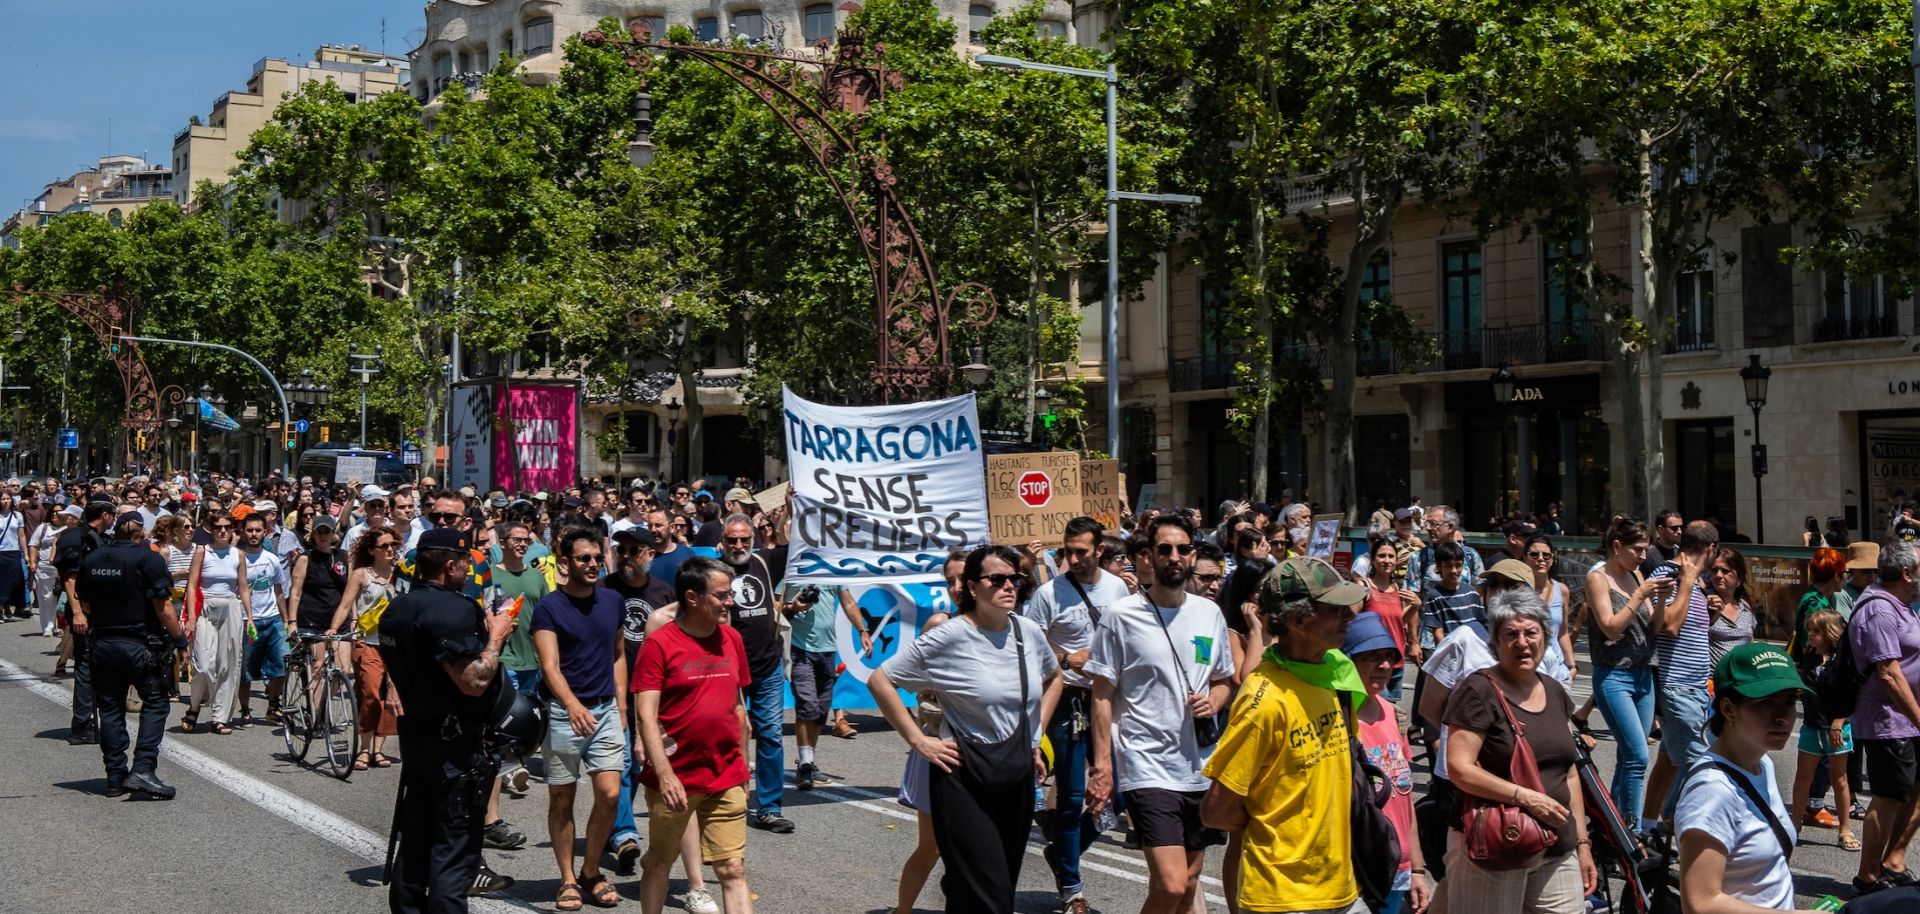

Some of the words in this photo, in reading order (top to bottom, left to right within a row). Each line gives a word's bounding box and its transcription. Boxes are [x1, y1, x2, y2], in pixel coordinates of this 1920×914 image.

[1511, 387, 1544, 401] ADA
[514, 419, 558, 443] WIN
[784, 408, 977, 463] TARRAGONA
[515, 445, 558, 469] WIN
[989, 457, 1031, 470] HABITANTS
[1040, 454, 1078, 468] TURISTES
[814, 468, 933, 514] SENSE
[1020, 481, 1048, 496] STOP
[1081, 480, 1108, 497] ING
[1082, 498, 1116, 515] ONA
[993, 513, 1036, 538] TURISME
[1751, 565, 1771, 576] Enjoy
[1755, 576, 1801, 585] masterpiece
[1251, 679, 1271, 710] MORE
